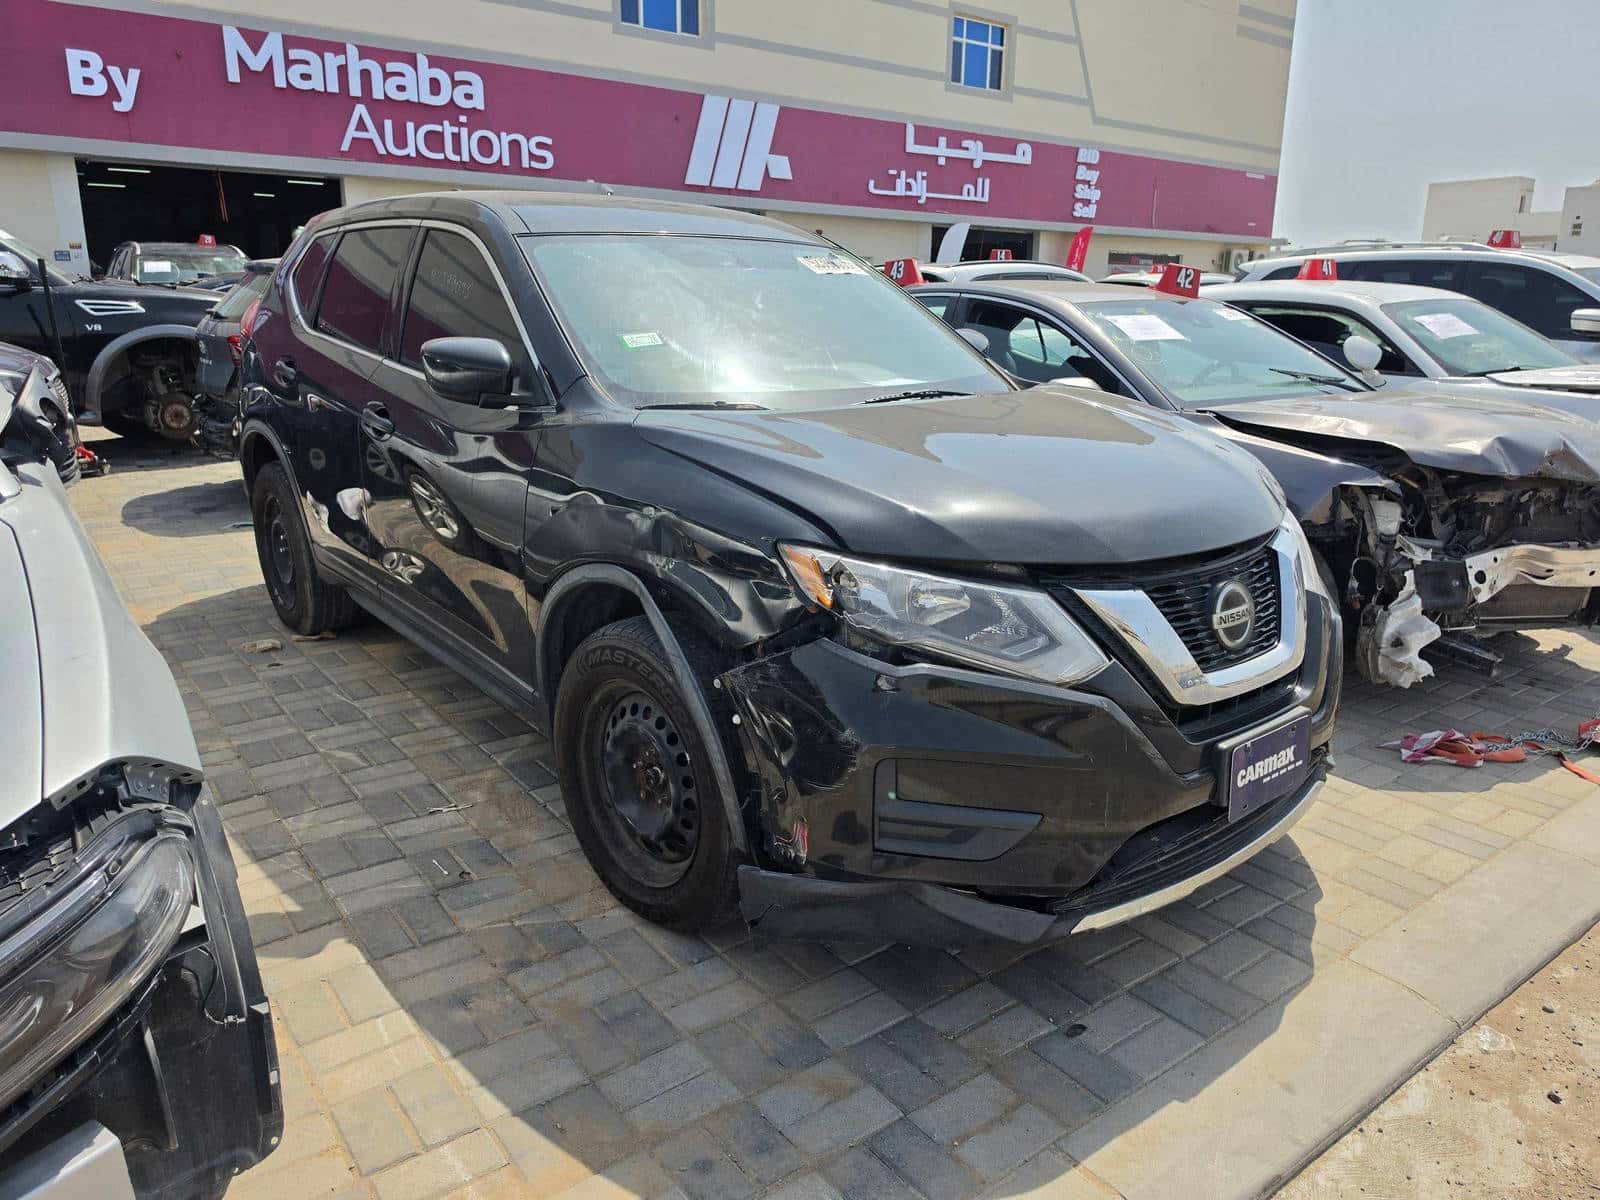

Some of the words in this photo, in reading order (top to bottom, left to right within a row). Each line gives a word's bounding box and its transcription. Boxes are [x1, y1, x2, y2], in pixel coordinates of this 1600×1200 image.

[65, 47, 140, 112] By
[222, 25, 485, 111] Marhaba
[340, 103, 554, 170] Auctions
[906, 122, 1032, 168] مرحبا
[1075, 164, 1100, 185] Buy
[868, 169, 990, 204] للمزادات
[1074, 184, 1101, 203] Ship
[1073, 202, 1097, 218] Sell
[889, 260, 905, 280] 43
[1321, 259, 1333, 276] 41
[1177, 267, 1195, 289] 42
[85, 323, 102, 331] V8
[1218, 607, 1252, 626] NISSAN
